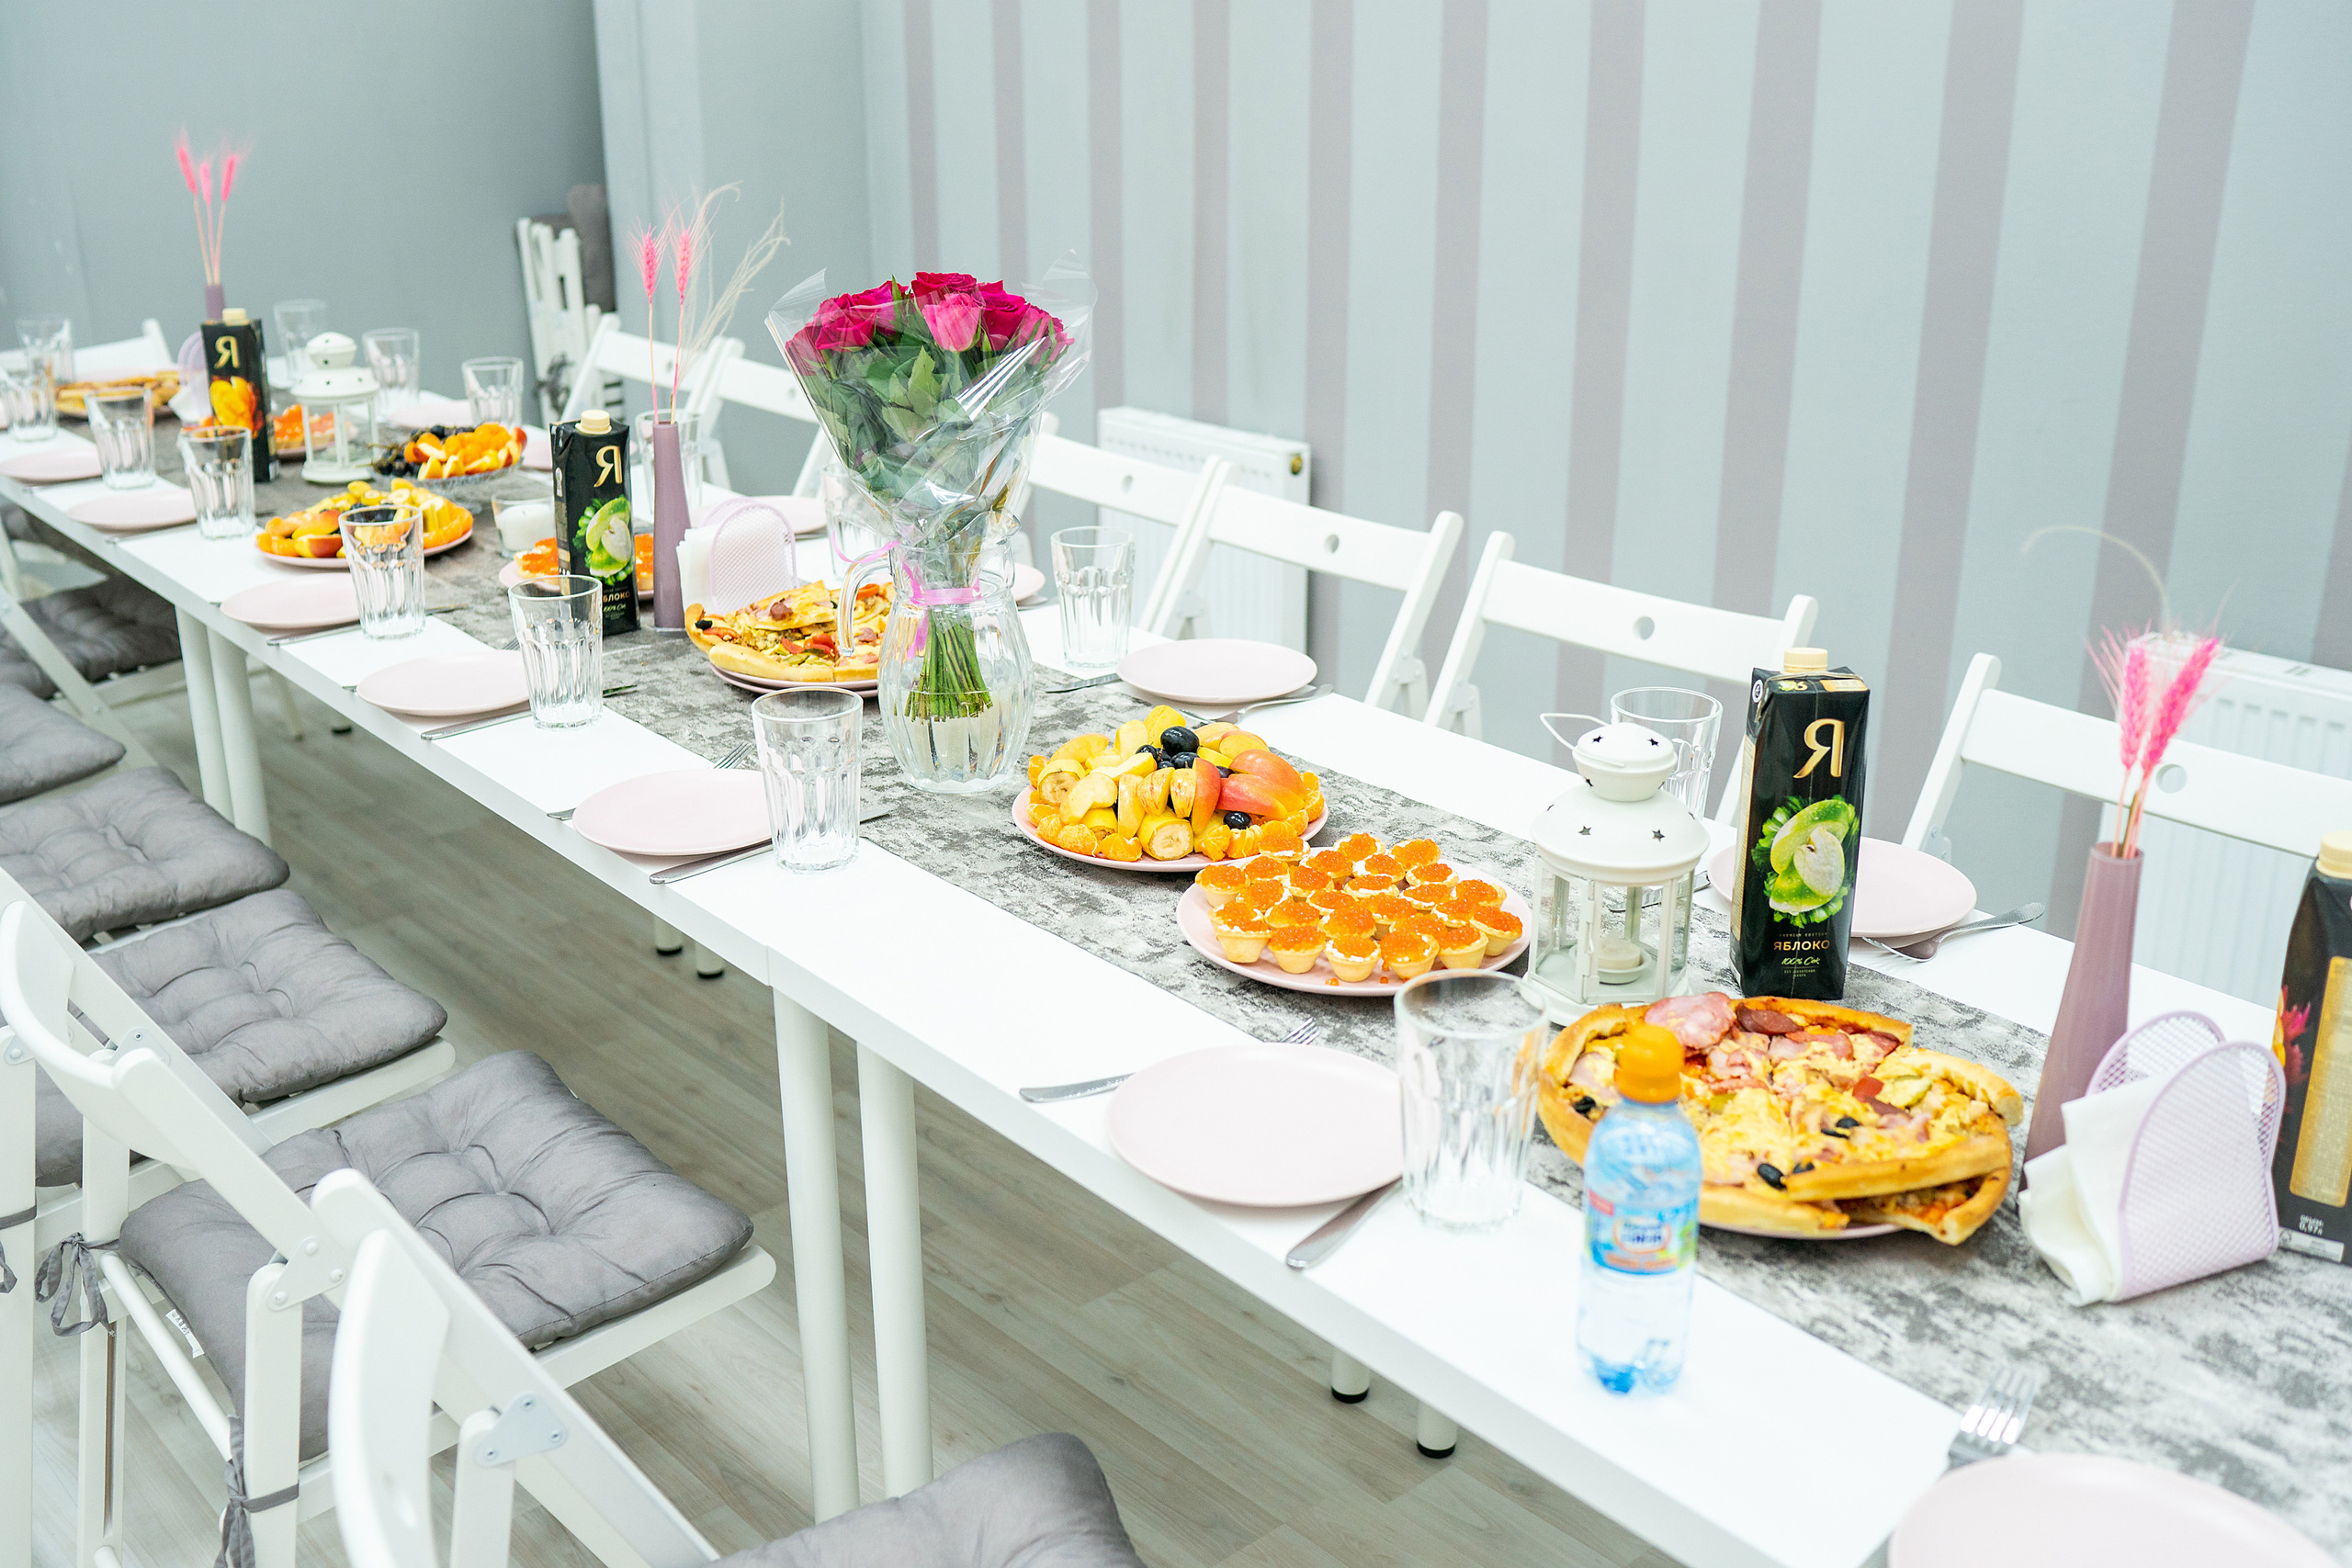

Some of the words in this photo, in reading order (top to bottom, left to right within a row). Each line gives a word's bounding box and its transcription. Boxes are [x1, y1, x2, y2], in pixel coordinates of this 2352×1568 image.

[214, 335, 240, 368] Я
[594, 446, 623, 487] Я
[603, 591, 630, 603] БЛОКО
[1792, 718, 1845, 778] Я
[1773, 940, 1830, 951] ЯБЛОКО
[1781, 957, 1803, 965] 100%
